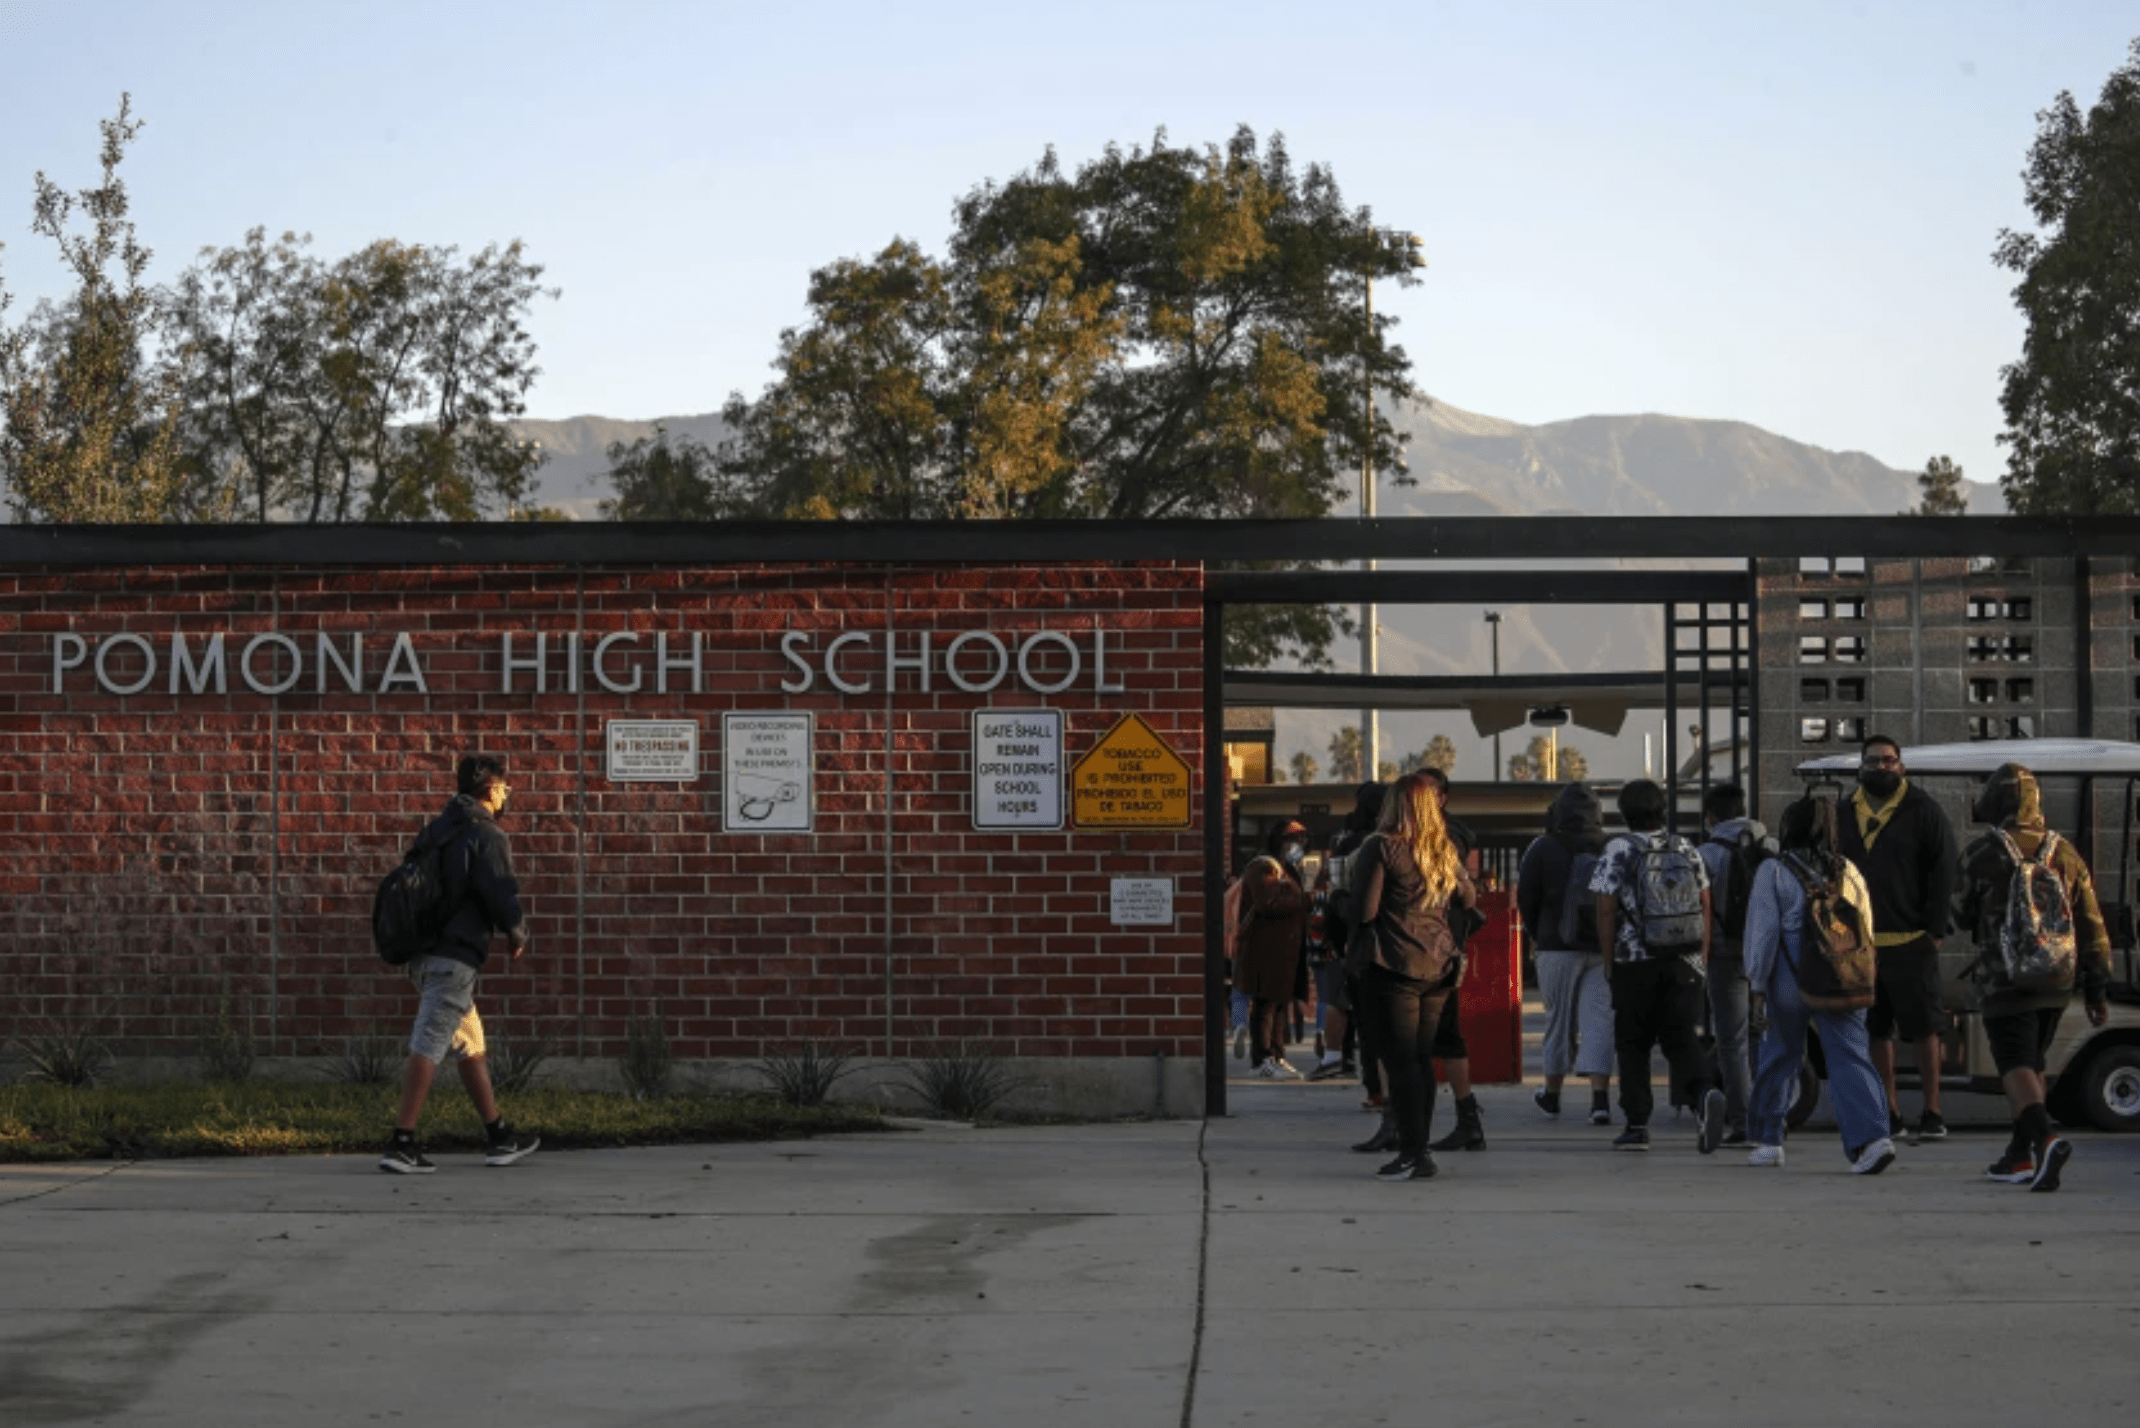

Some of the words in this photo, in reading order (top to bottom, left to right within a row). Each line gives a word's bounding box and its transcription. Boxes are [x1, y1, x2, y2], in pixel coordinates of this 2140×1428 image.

[53, 631, 428, 695] POMONA
[503, 631, 702, 694] HIGH
[781, 630, 1125, 694] SCHOOL
[983, 724, 1013, 738] GATE
[1015, 724, 1052, 738] SHALL
[997, 744, 1040, 756] REMAIN
[979, 763, 1011, 775] OPEN
[1012, 763, 1056, 775] DURING
[1118, 760, 1143, 771] USE
[994, 781, 1042, 794] SCHOOL
[997, 800, 1038, 813] HOURS
